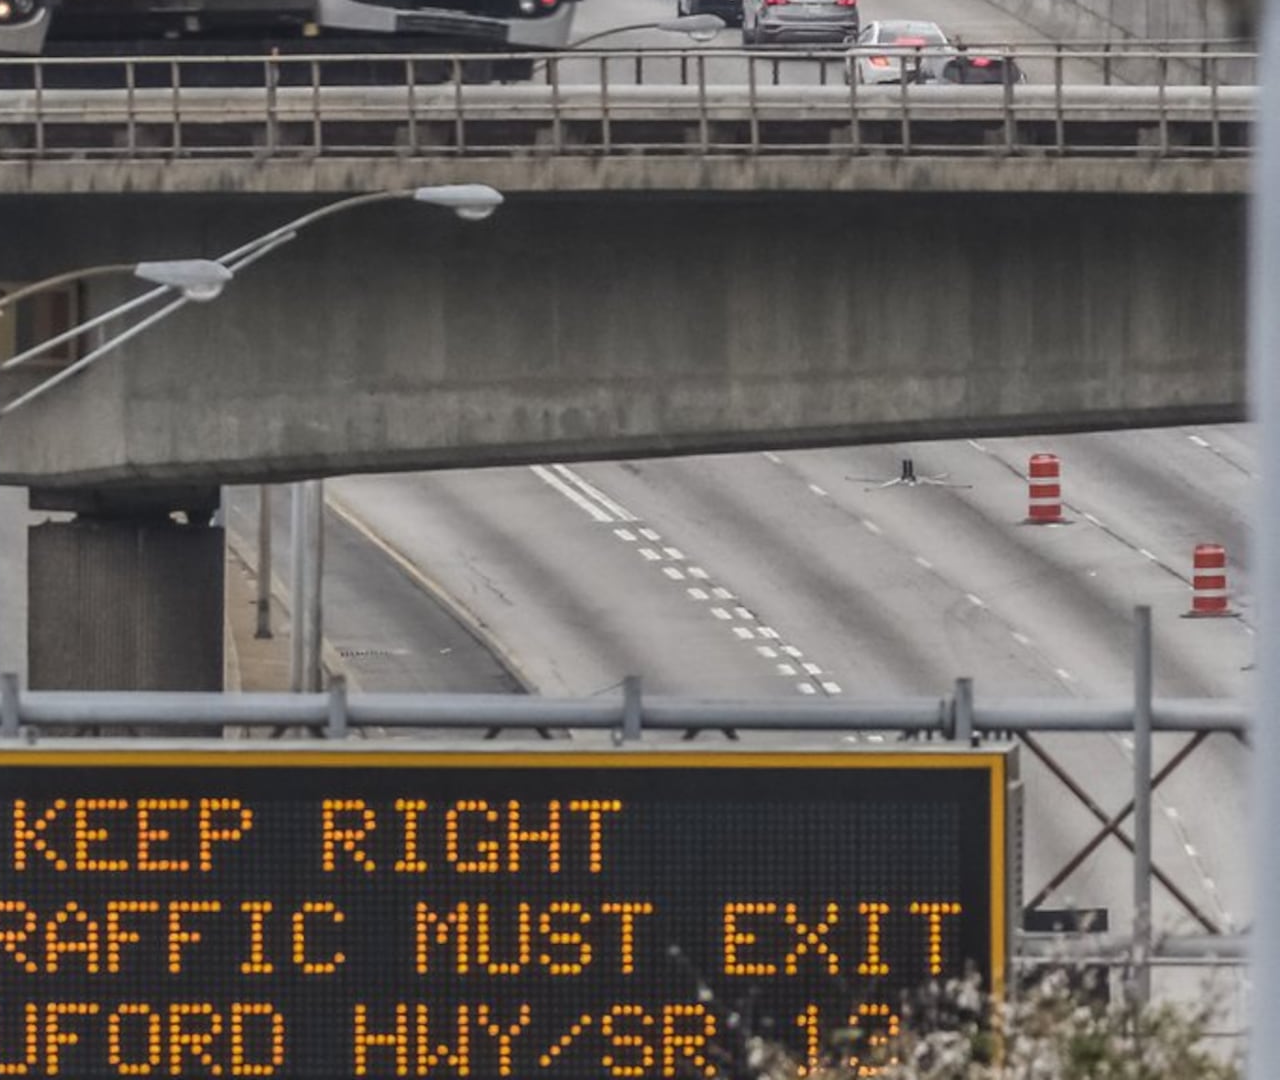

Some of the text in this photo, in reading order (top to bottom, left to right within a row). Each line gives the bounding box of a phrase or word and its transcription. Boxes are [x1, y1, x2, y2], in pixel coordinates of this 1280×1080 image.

[12, 798, 622, 872] KEEP RIGHT
[415, 899, 652, 974] MUST
[723, 899, 960, 975] EXIT
[353, 1002, 717, 1077] HWY/SR
